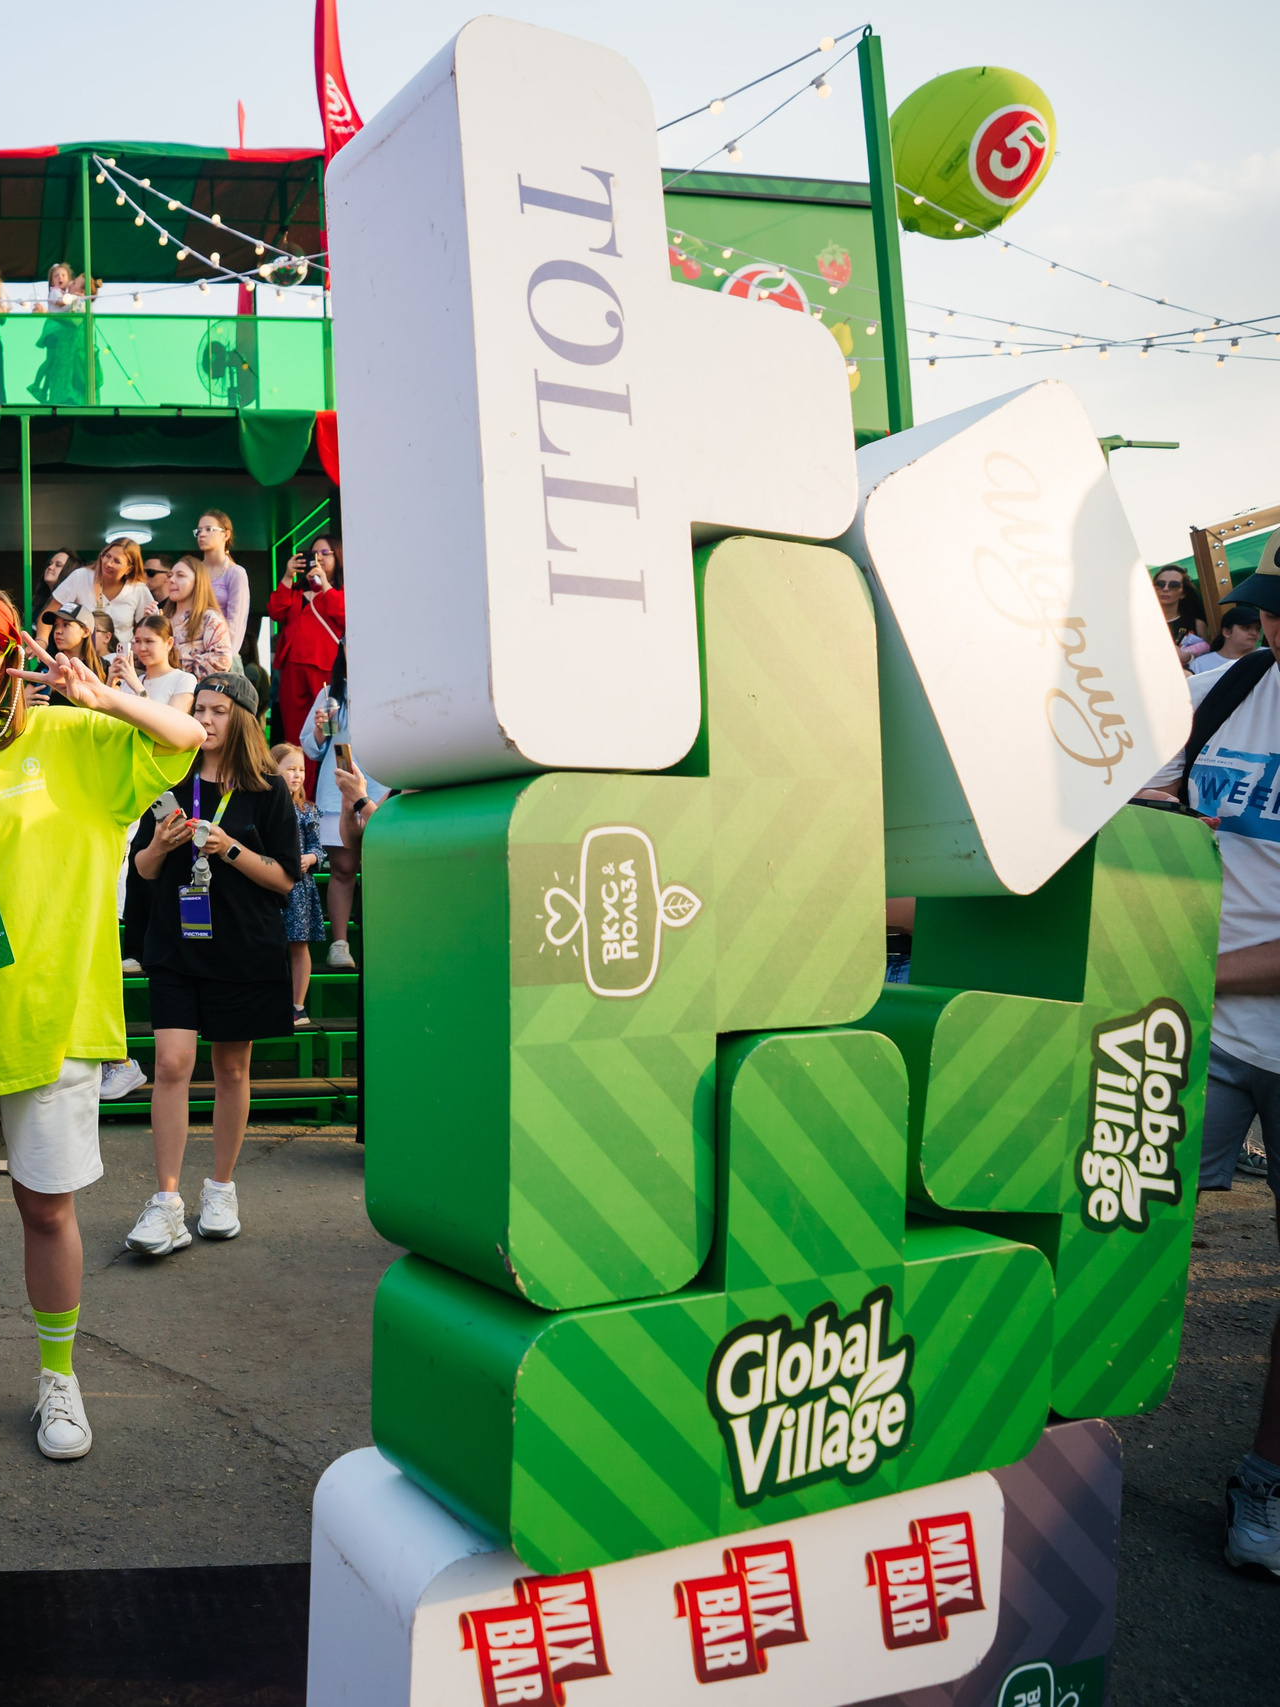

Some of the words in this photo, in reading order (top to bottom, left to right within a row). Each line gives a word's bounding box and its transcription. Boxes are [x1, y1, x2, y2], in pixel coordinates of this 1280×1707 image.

[989, 120, 1045, 182] 5
[517, 166, 647, 614] TOLLI
[602, 862, 615, 876] &
[619, 859, 639, 959] ПОЛЬЗА
[601, 881, 621, 965] ВКУС
[1082, 1020, 1145, 1223] Village
[1132, 1008, 1186, 1222] Global
[716, 1299, 906, 1415] Global
[729, 1393, 906, 1495] Village
[744, 1551, 795, 1638] MIX
[885, 1555, 931, 1637] BAR
[928, 1522, 974, 1608] MIX
[484, 1617, 544, 1706] BAR
[538, 1581, 596, 1674] MIX
[696, 1585, 747, 1671] BAR
